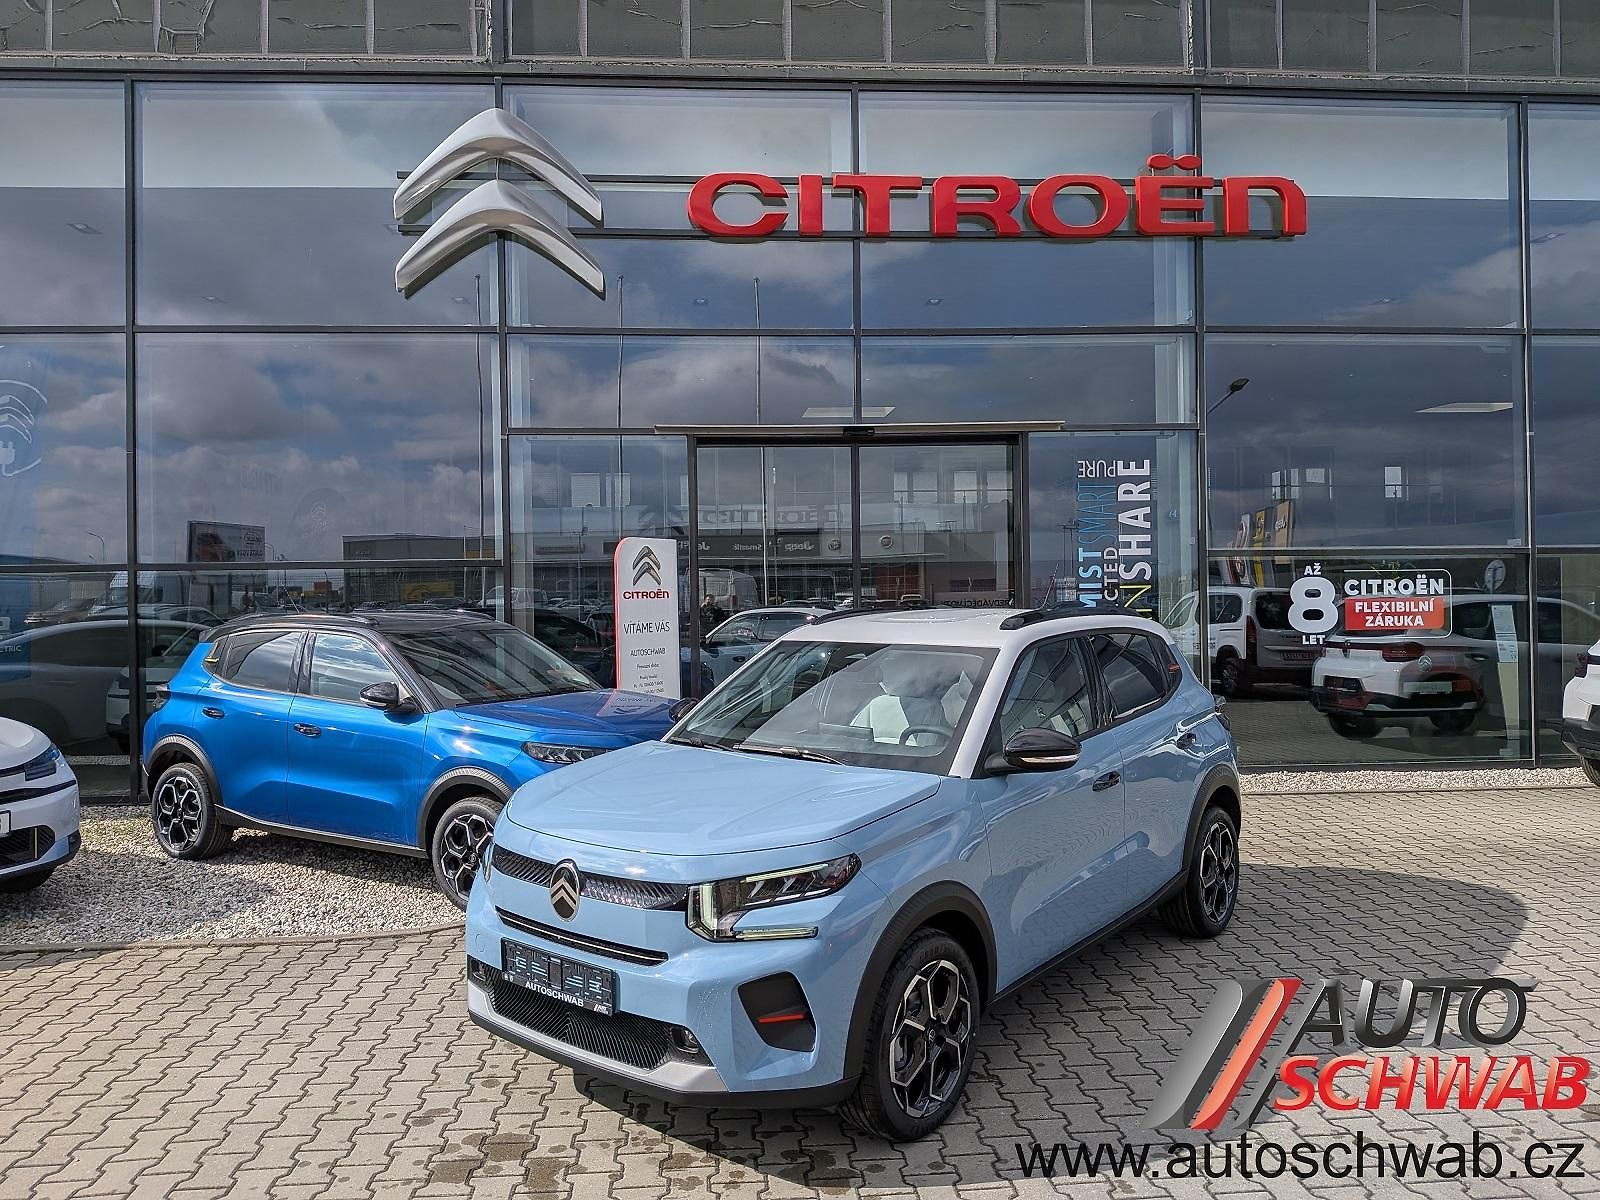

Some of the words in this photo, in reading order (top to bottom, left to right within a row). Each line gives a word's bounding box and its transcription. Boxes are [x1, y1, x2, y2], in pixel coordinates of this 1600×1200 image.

[687, 153, 1308, 237] CITROËN
[1077, 459, 1116, 478] PURE
[1077, 482, 1118, 545] SMART
[1117, 459, 1152, 581] SHARE
[1103, 547, 1119, 606] CTED
[1303, 562, 1322, 576] AŽ
[623, 588, 670, 600] CITROËN
[1344, 574, 1444, 596] CITROËN
[1288, 576, 1339, 633] 8
[1355, 598, 1435, 613] FLEXIBILNÍ
[623, 620, 654, 634] VÍTÁME
[654, 619, 671, 633] VÁS
[1365, 613, 1425, 628] ZÁRUKA
[1302, 634, 1326, 645] LET
[630, 647, 666, 657] AUTOSCHWAB
[526, 981, 584, 1007] AUTOSCHWAB
